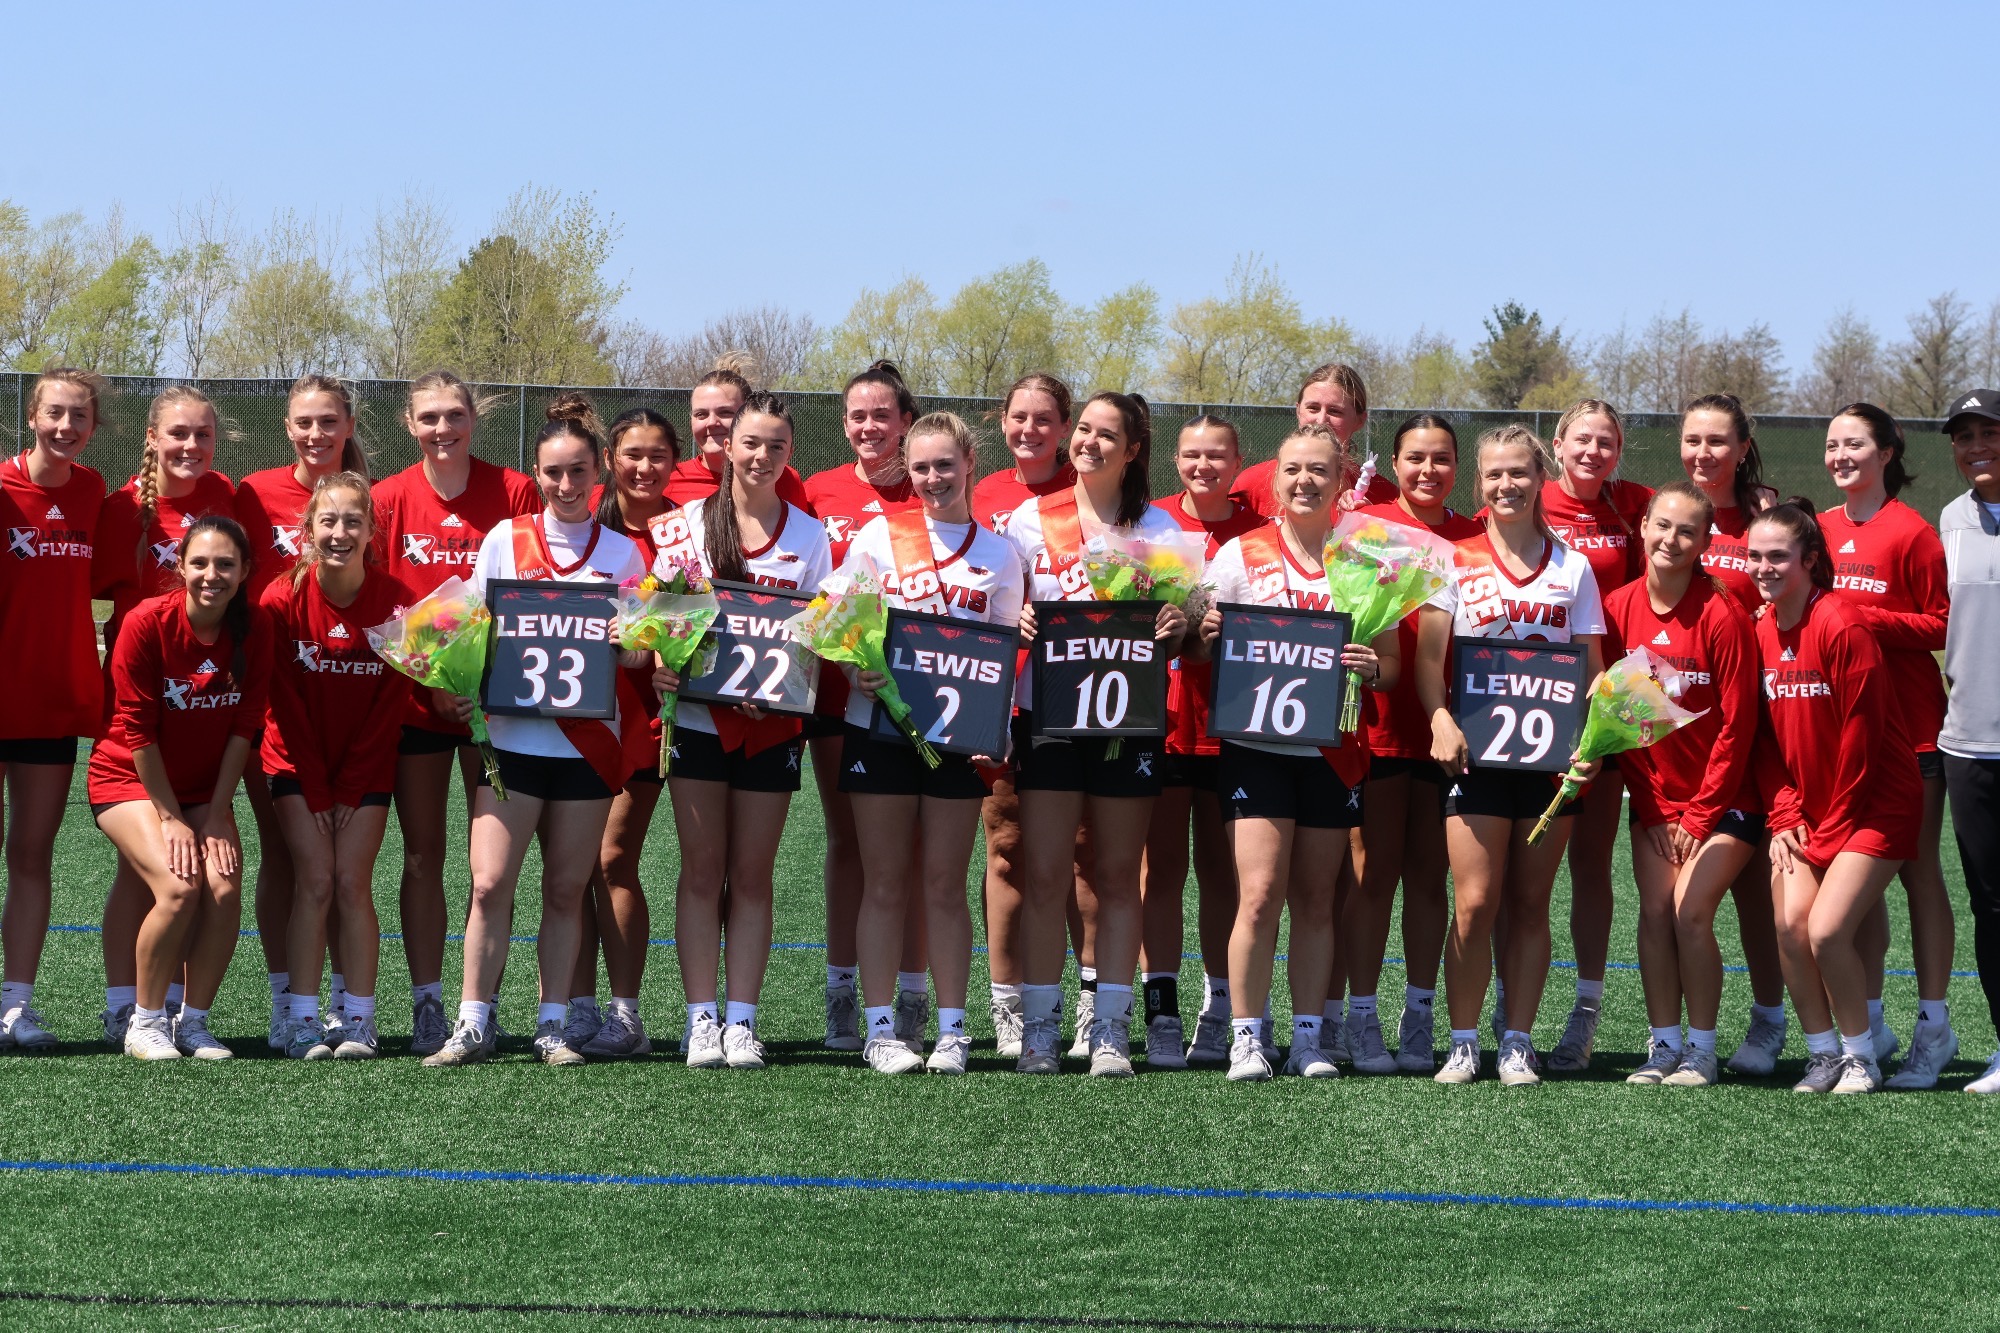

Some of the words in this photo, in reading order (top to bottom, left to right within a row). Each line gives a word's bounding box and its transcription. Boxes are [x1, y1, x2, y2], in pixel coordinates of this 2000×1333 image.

[41, 530, 87, 542] LEWIS
[1575, 524, 1623, 538] LEWIS
[1249, 561, 1281, 577] Emma
[1834, 562, 1876, 577] EWIS
[497, 614, 608, 641] LEWIS
[1502, 598, 1567, 629] WIS
[327, 631, 350, 639] adidas
[1045, 637, 1155, 663] LEWIS
[892, 647, 1003, 685] LEWIS
[1224, 639, 1336, 671] LEWIS
[514, 647, 586, 708] 33
[717, 644, 791, 703] 22
[1465, 673, 1576, 704] LEWIS
[1071, 670, 1130, 729] 10
[1244, 675, 1308, 736] 16
[1776, 683, 1832, 698] FLYERS
[924, 686, 961, 744] 2
[1480, 705, 1555, 765] 29
